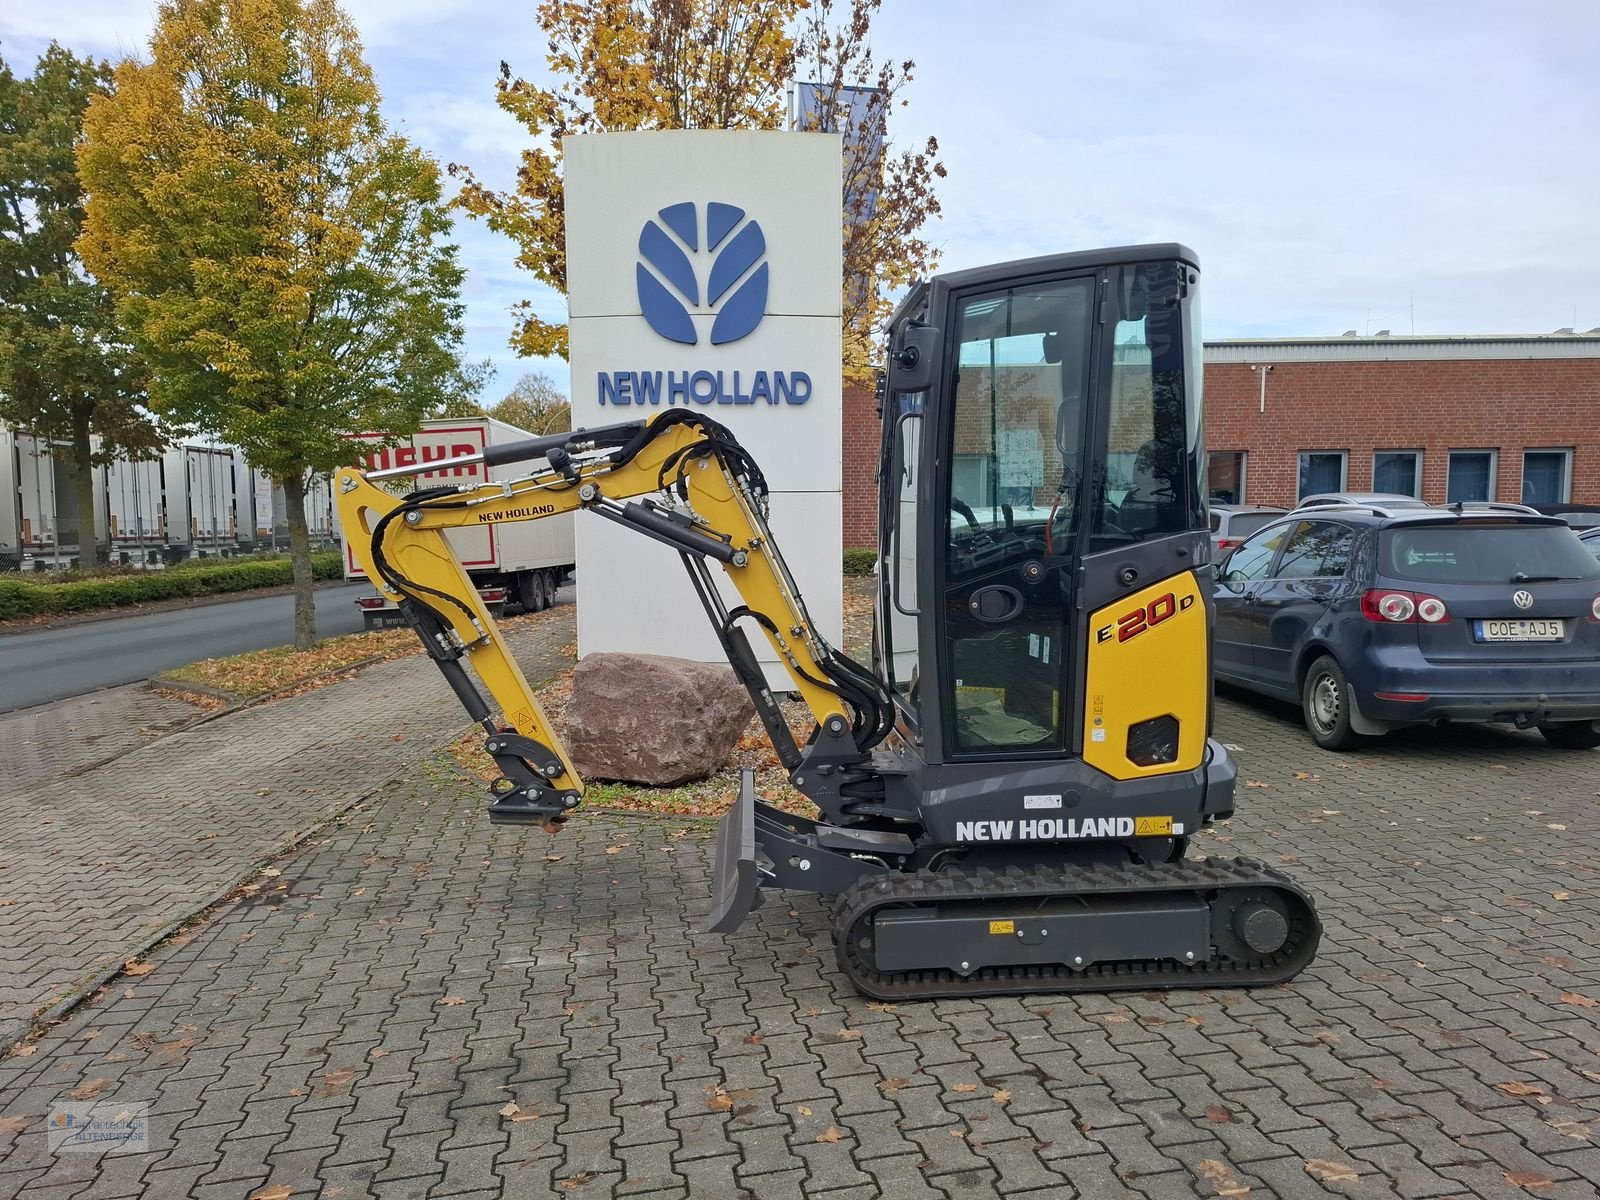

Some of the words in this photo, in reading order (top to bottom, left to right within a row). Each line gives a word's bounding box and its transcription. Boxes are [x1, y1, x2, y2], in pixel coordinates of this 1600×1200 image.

[597, 370, 663, 405] NEW
[667, 369, 813, 405] HOLLAND
[478, 511, 503, 523] NEW
[505, 504, 555, 519] HOLLAND
[1489, 622, 1518, 636] COE
[956, 820, 1014, 841] NEW
[1019, 816, 1135, 840] HOLLAND
